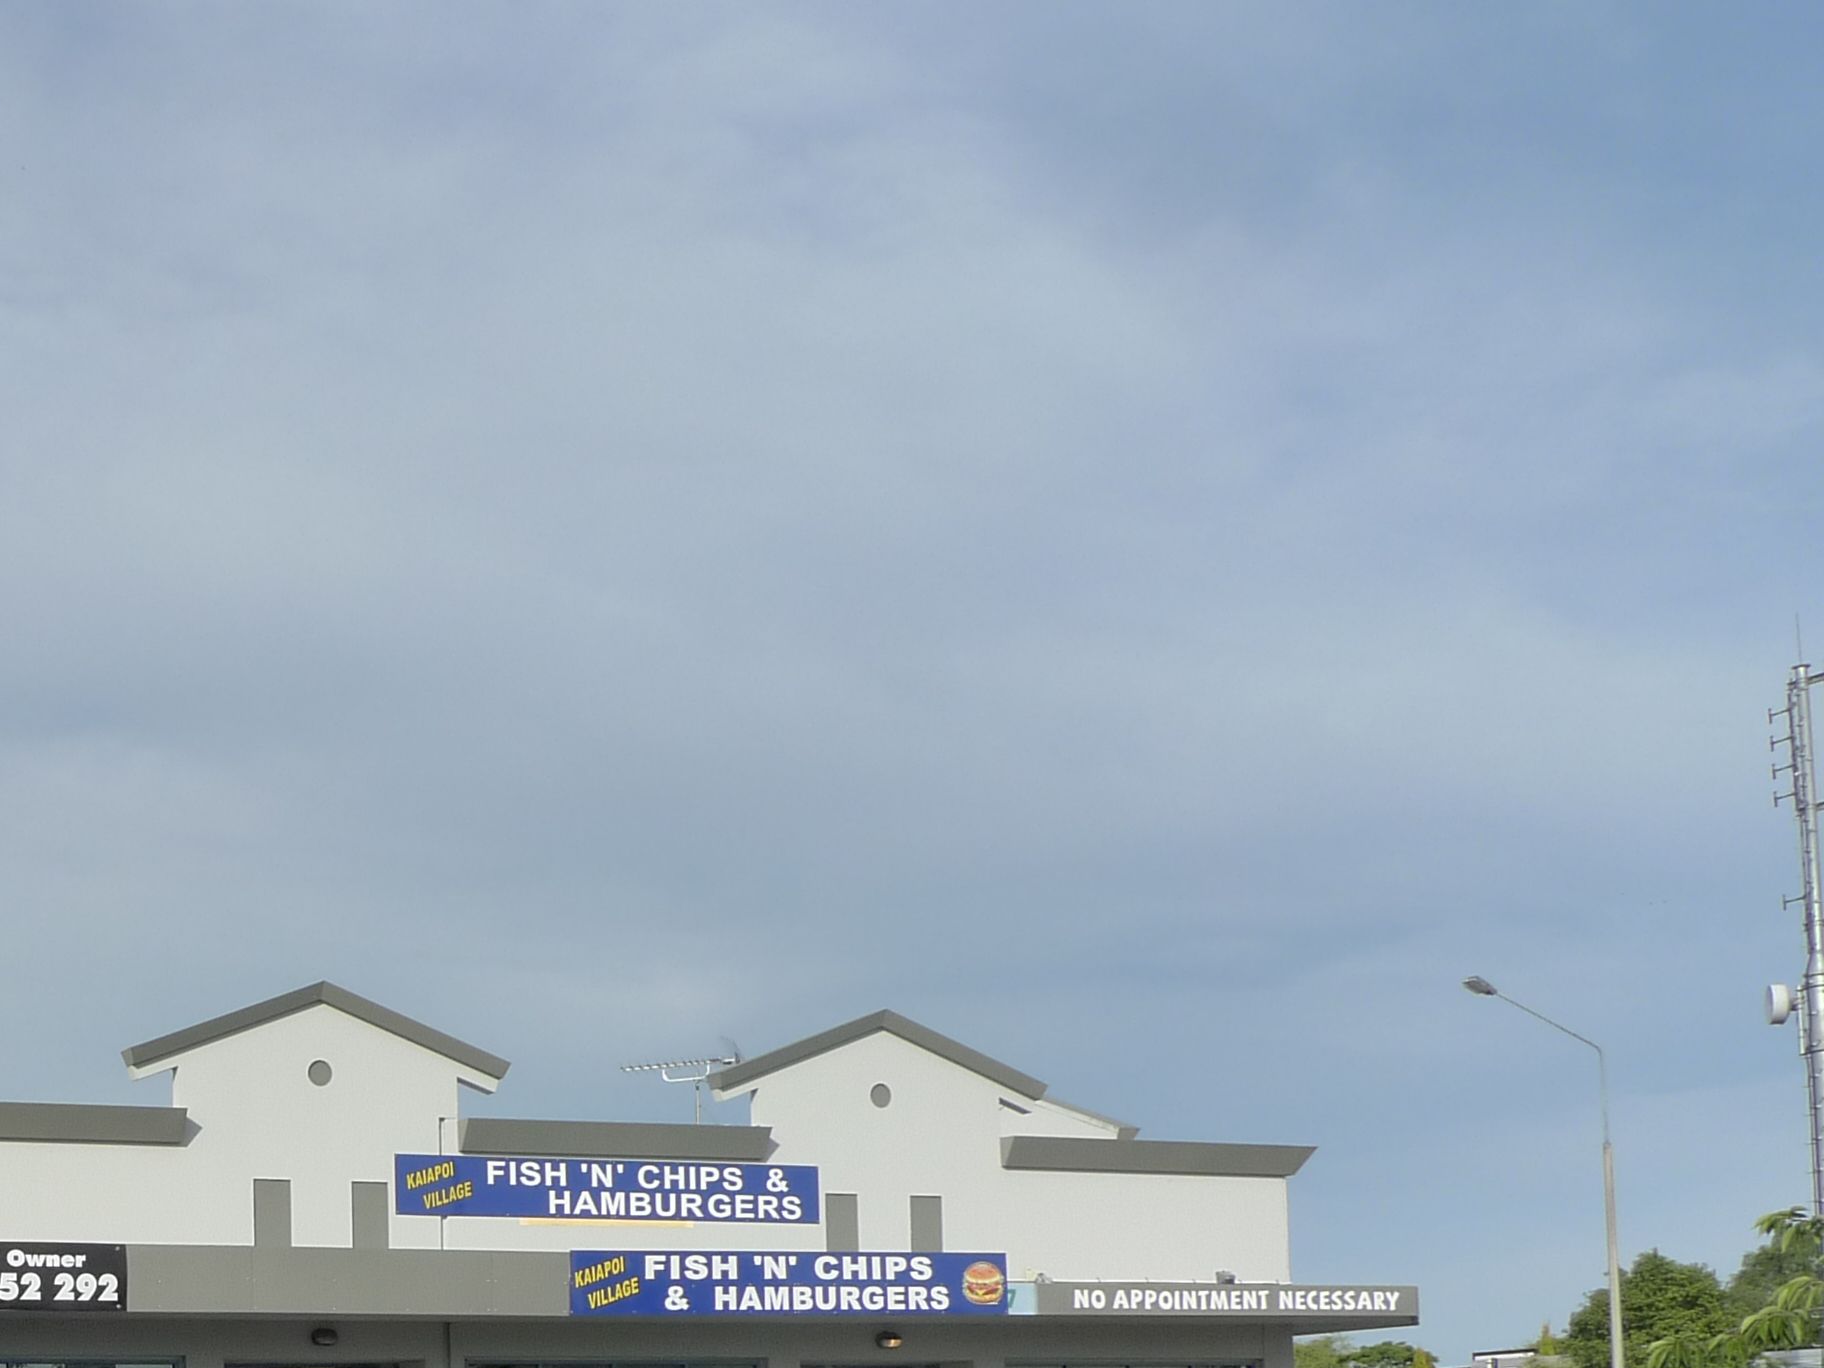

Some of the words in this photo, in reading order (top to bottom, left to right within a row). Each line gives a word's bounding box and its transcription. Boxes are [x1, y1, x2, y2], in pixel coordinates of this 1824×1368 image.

[406, 1161, 455, 1190] KAIAPOI
[486, 1161, 567, 1187] FISH
[580, 1163, 624, 1189] 'N'
[637, 1165, 743, 1191] CHIPS
[766, 1167, 789, 1193] &
[423, 1181, 473, 1209] VILLAGE
[549, 1191, 802, 1220] HAMBURGERS
[6, 1250, 86, 1268] Owner
[574, 1256, 626, 1289] KAIAPOI
[644, 1255, 738, 1280] FISH
[753, 1255, 797, 1280] 'N'
[814, 1255, 933, 1280] CHIPS
[54, 1273, 119, 1302] 292
[587, 1276, 640, 1309] VILLAGE
[664, 1285, 690, 1311] &
[714, 1285, 950, 1311] HAMBURGERS
[1074, 1289, 1106, 1309] NO
[1113, 1289, 1270, 1311] APPOINTMENT
[1279, 1291, 1400, 1312] NECESSARY
